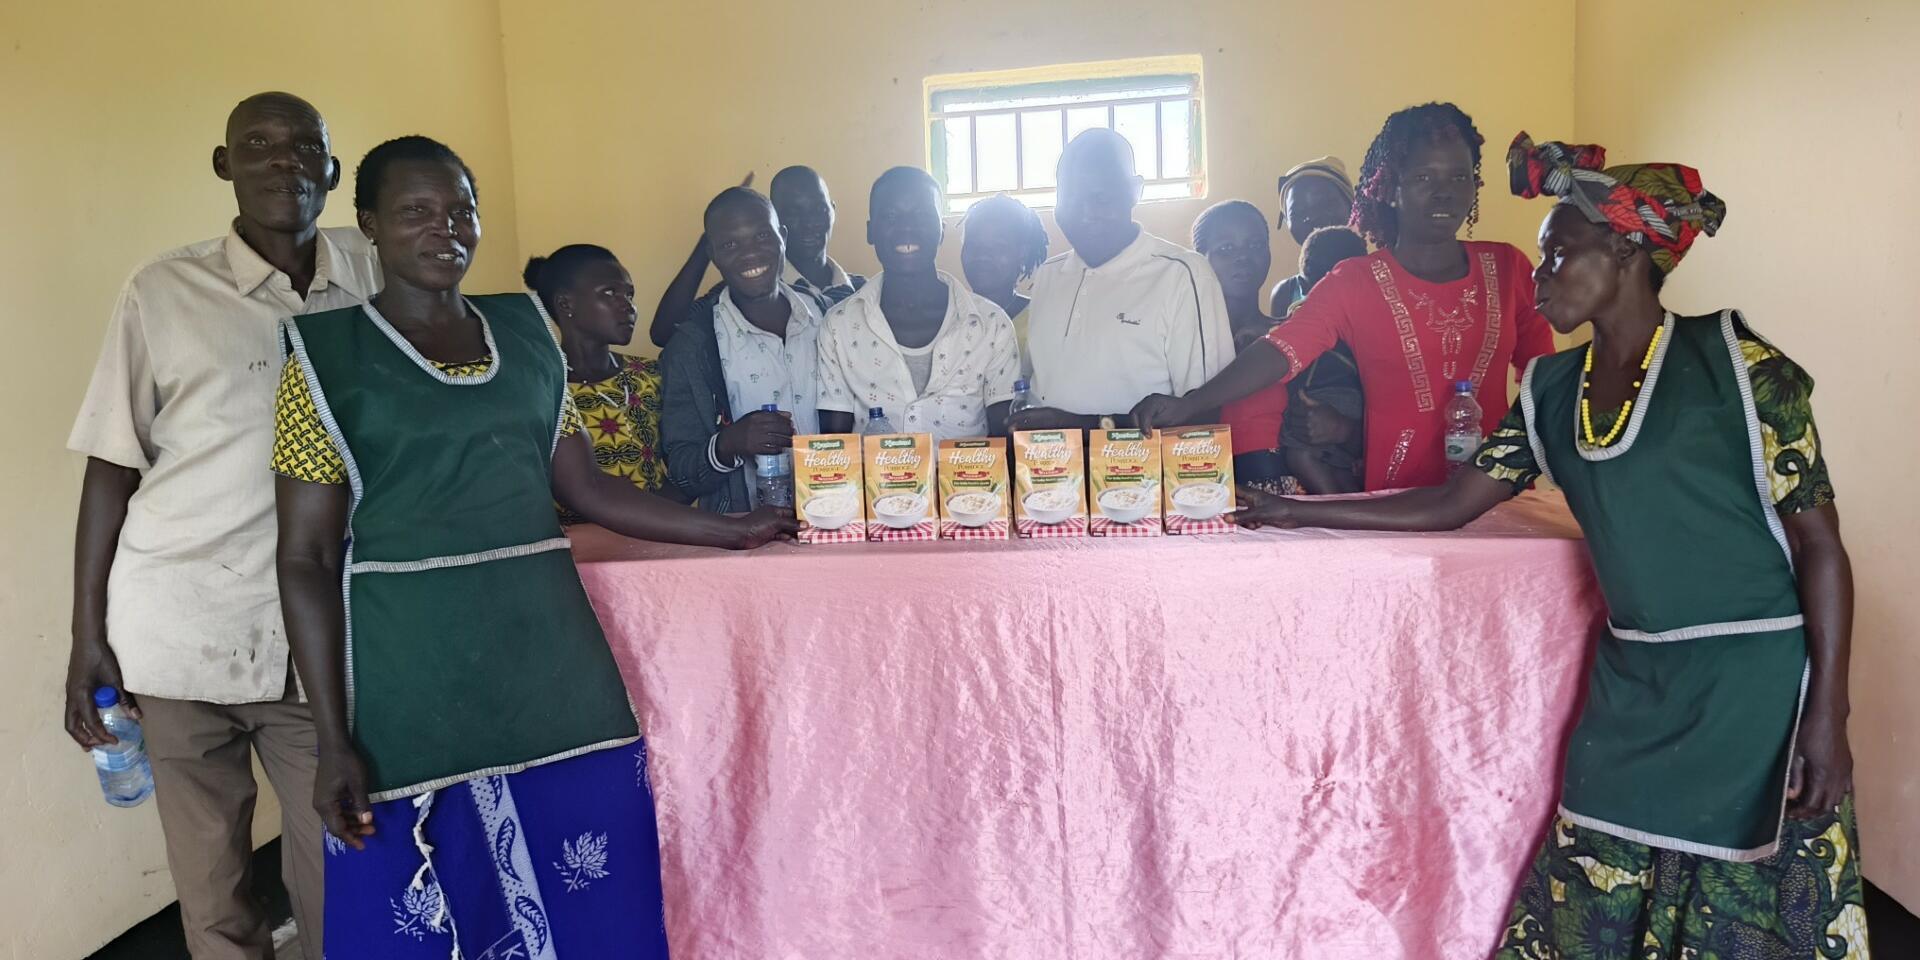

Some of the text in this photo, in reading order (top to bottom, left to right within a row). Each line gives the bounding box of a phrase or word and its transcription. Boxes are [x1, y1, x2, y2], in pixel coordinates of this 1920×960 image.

[1024, 444, 1072, 463] Healthy
[1101, 441, 1150, 462] Healthy
[1172, 439, 1221, 458] Healthy
[804, 451, 850, 469] Healthy
[875, 450, 920, 468] Healthy
[948, 449, 995, 467] Healthy
